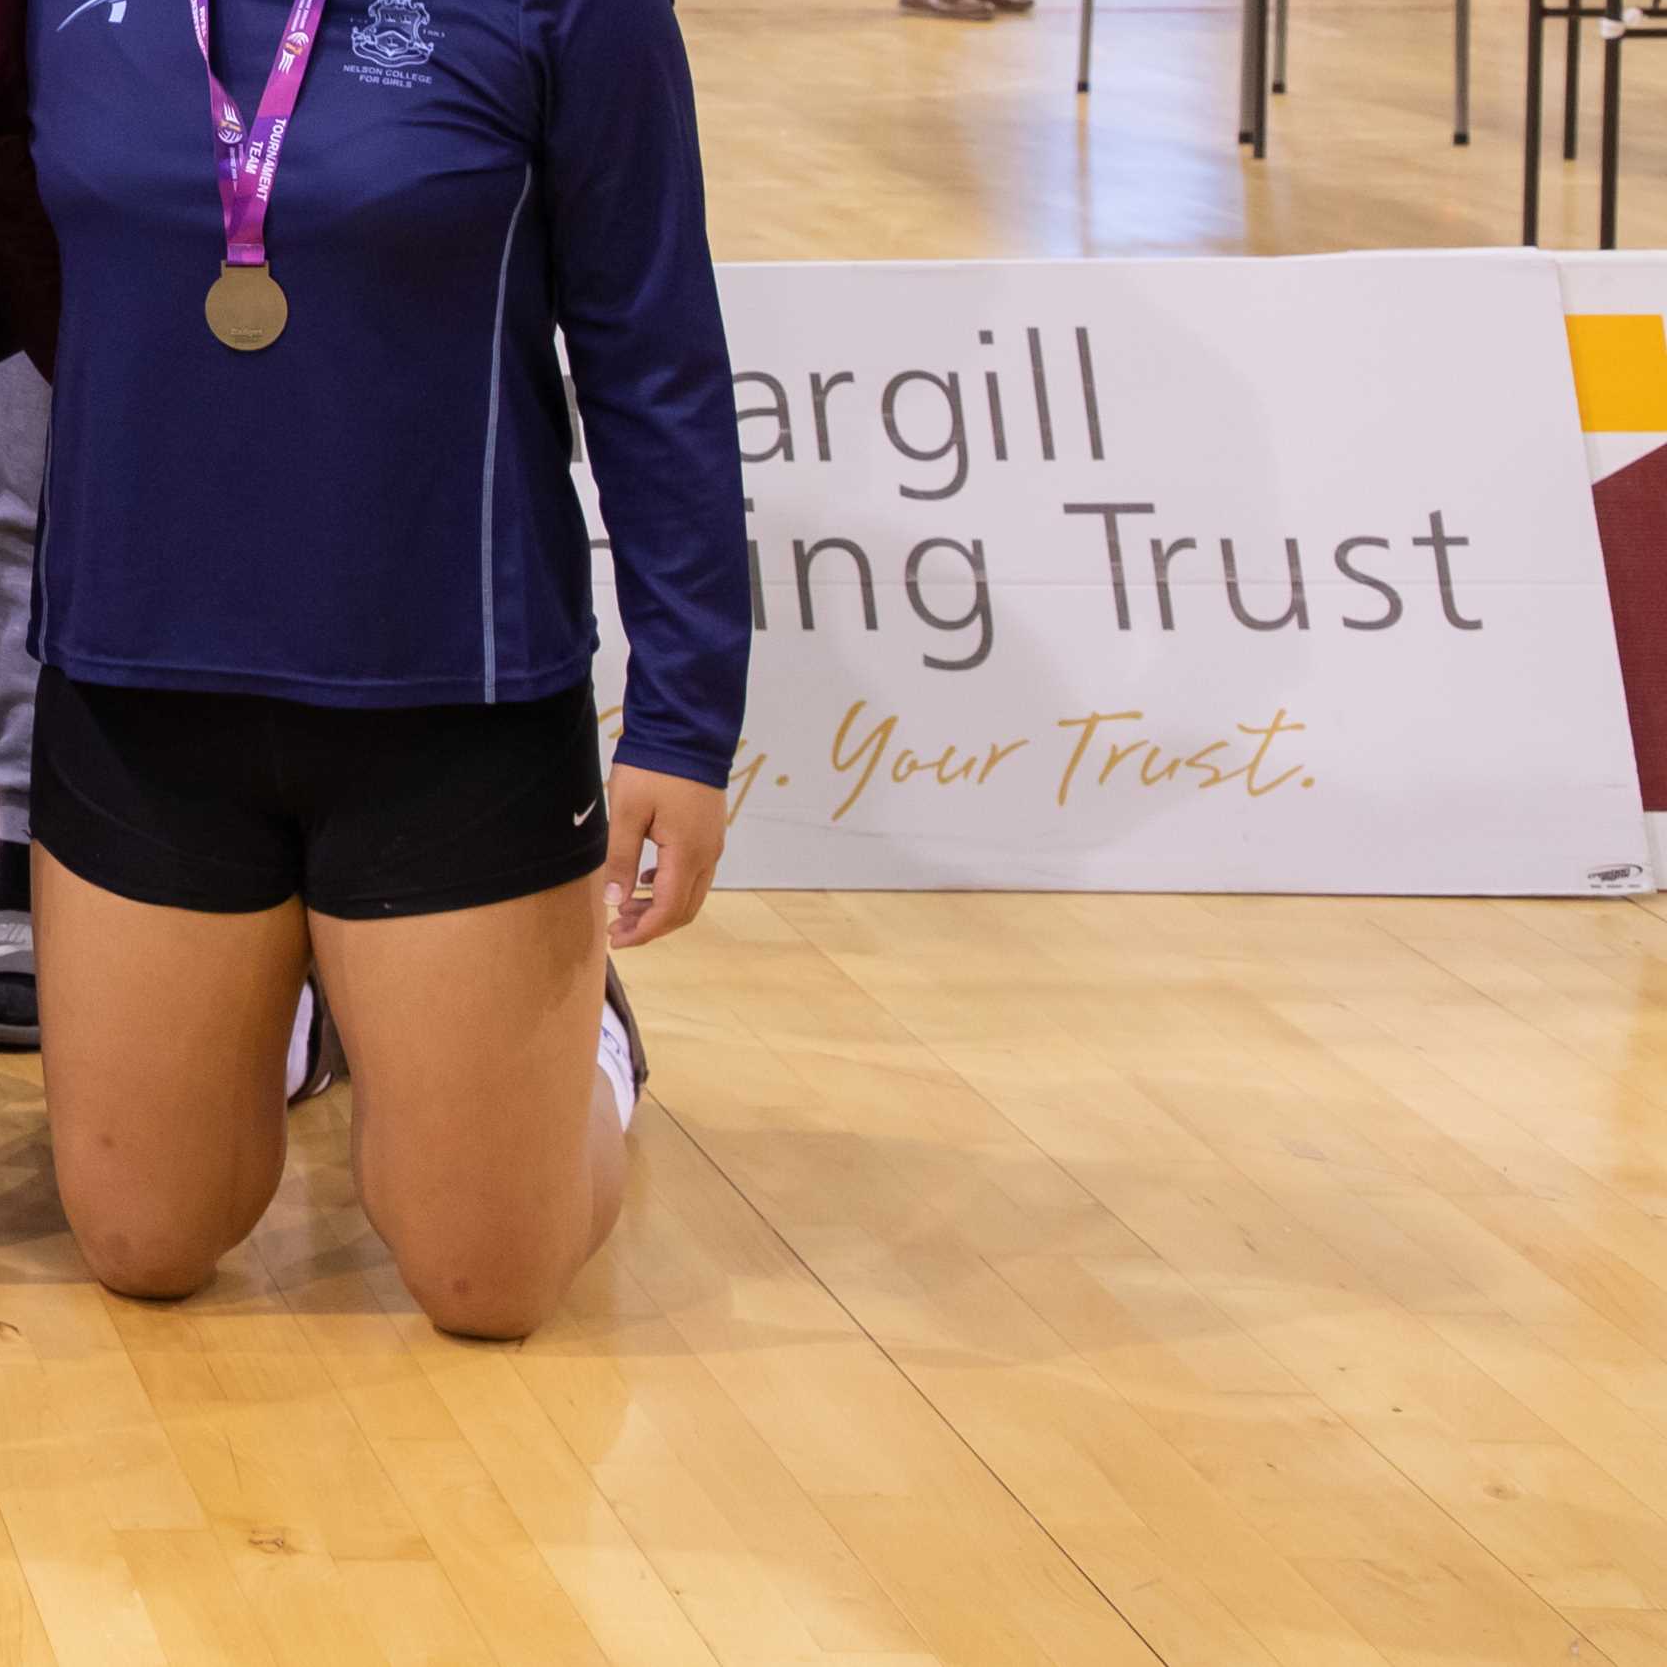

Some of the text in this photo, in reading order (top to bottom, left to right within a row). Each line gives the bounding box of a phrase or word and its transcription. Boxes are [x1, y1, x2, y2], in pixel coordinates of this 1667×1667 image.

[343, 64, 433, 84] NELSON COLLEGE
[359, 74, 413, 88] FOR GIRLS
[245, 141, 264, 174] TEAM
[256, 118, 287, 201] TOURNAMENT
[732, 327, 1105, 500] argill
[746, 497, 1483, 671] ing Trust
[831, 700, 1029, 822] Your
[1058, 707, 1317, 806] Trust.
